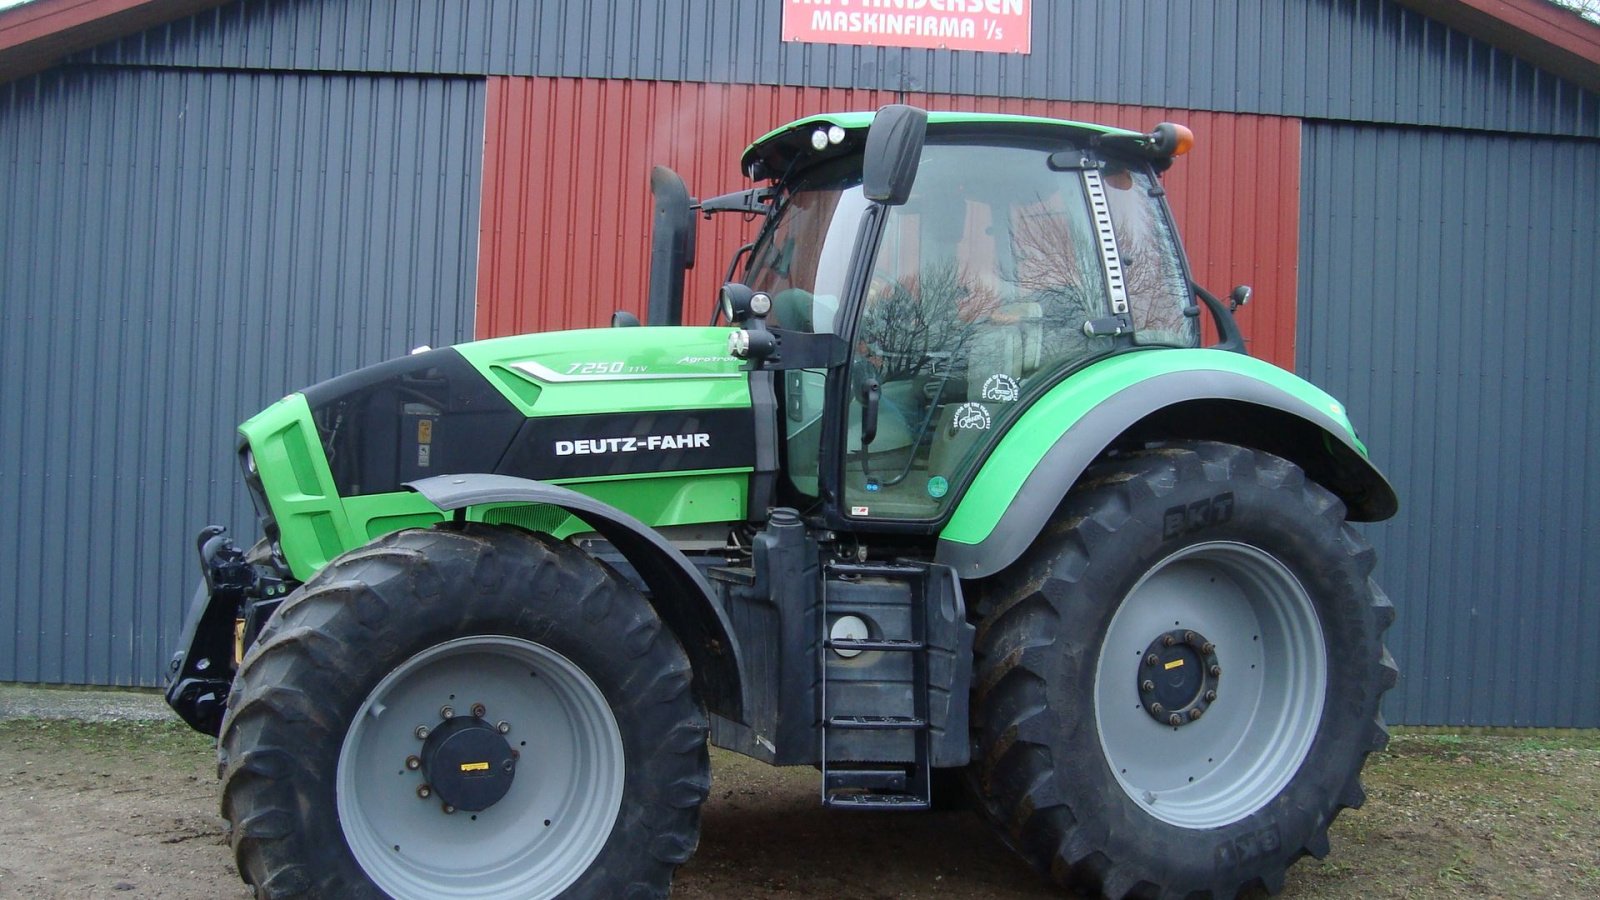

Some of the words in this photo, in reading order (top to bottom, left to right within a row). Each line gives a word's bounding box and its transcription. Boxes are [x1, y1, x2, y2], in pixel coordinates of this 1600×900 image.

[810, 10, 975, 38] MASKINFIRMA
[566, 362, 624, 375] 7250
[555, 433, 711, 456] DEUTZ-FAHR
[1163, 491, 1234, 540] BKT
